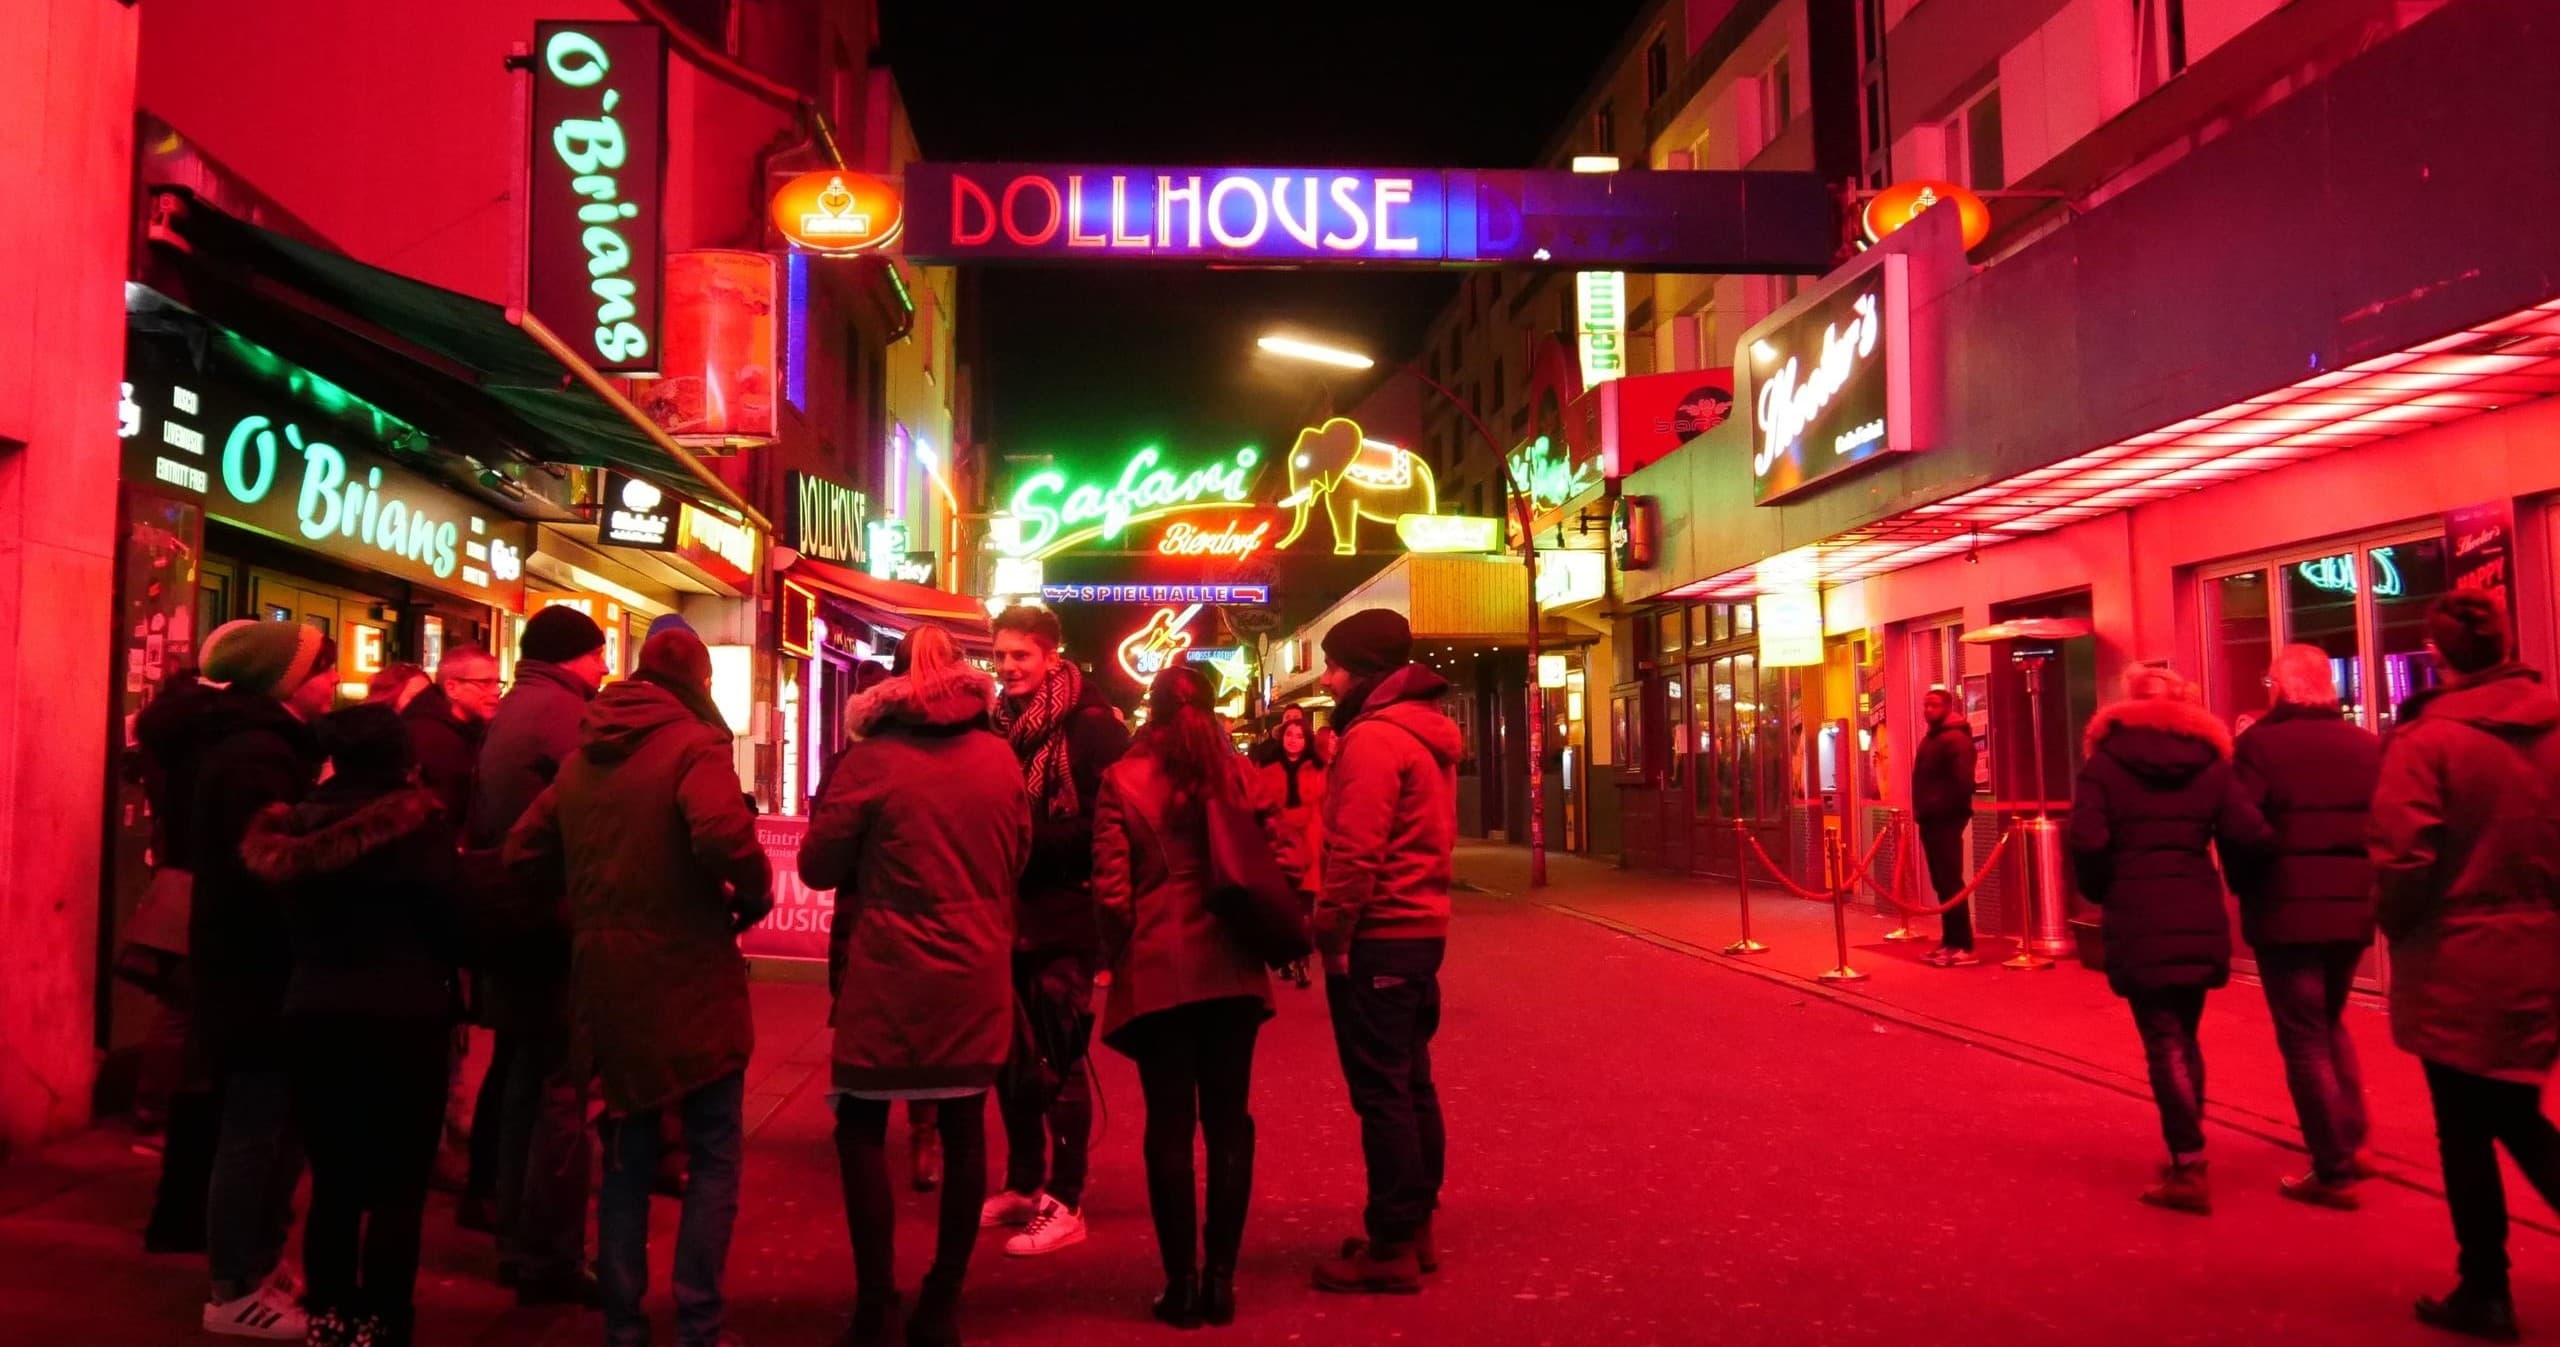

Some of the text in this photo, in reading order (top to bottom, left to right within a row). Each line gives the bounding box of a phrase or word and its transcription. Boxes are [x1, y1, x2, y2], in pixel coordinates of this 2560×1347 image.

[952, 173, 1418, 252] DOLLHOUSE
[799, 470, 867, 564] DOLLHOUSE
[1157, 519, 1270, 562] Bierdorf
[1081, 585, 1228, 602] SPIELHALLE
[757, 828, 804, 846] Eintri
[776, 870, 835, 907] IVE
